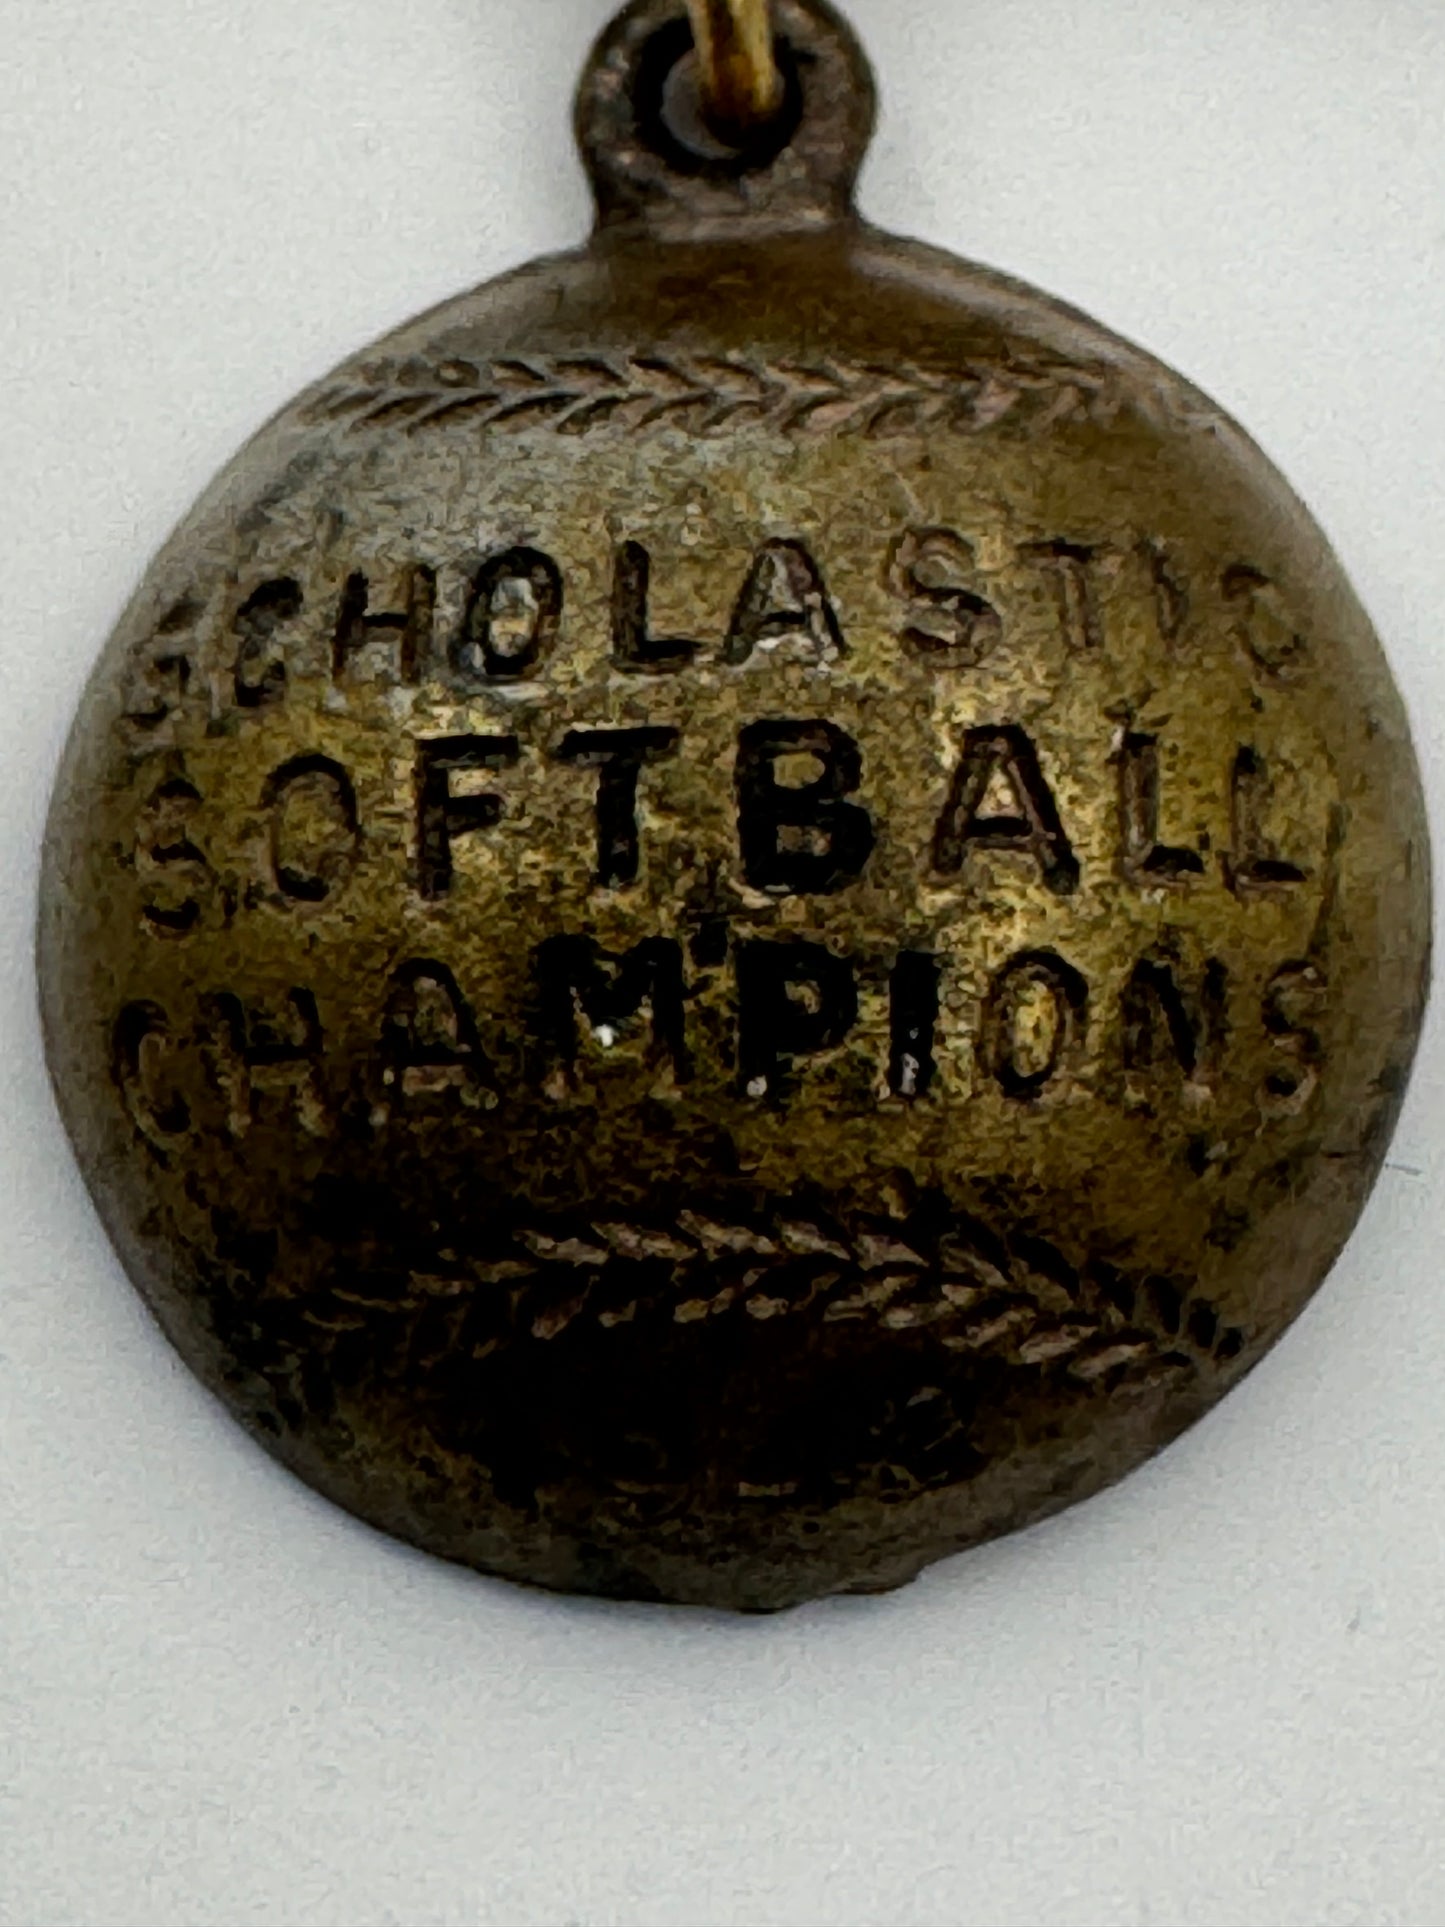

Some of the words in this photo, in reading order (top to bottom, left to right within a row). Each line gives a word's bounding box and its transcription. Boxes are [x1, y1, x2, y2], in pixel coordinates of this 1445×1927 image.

[124, 527, 1308, 728] SCHOLASTIC
[135, 718, 1312, 937] SOFTBALL
[111, 933, 1327, 1142] CHAMPIONS
